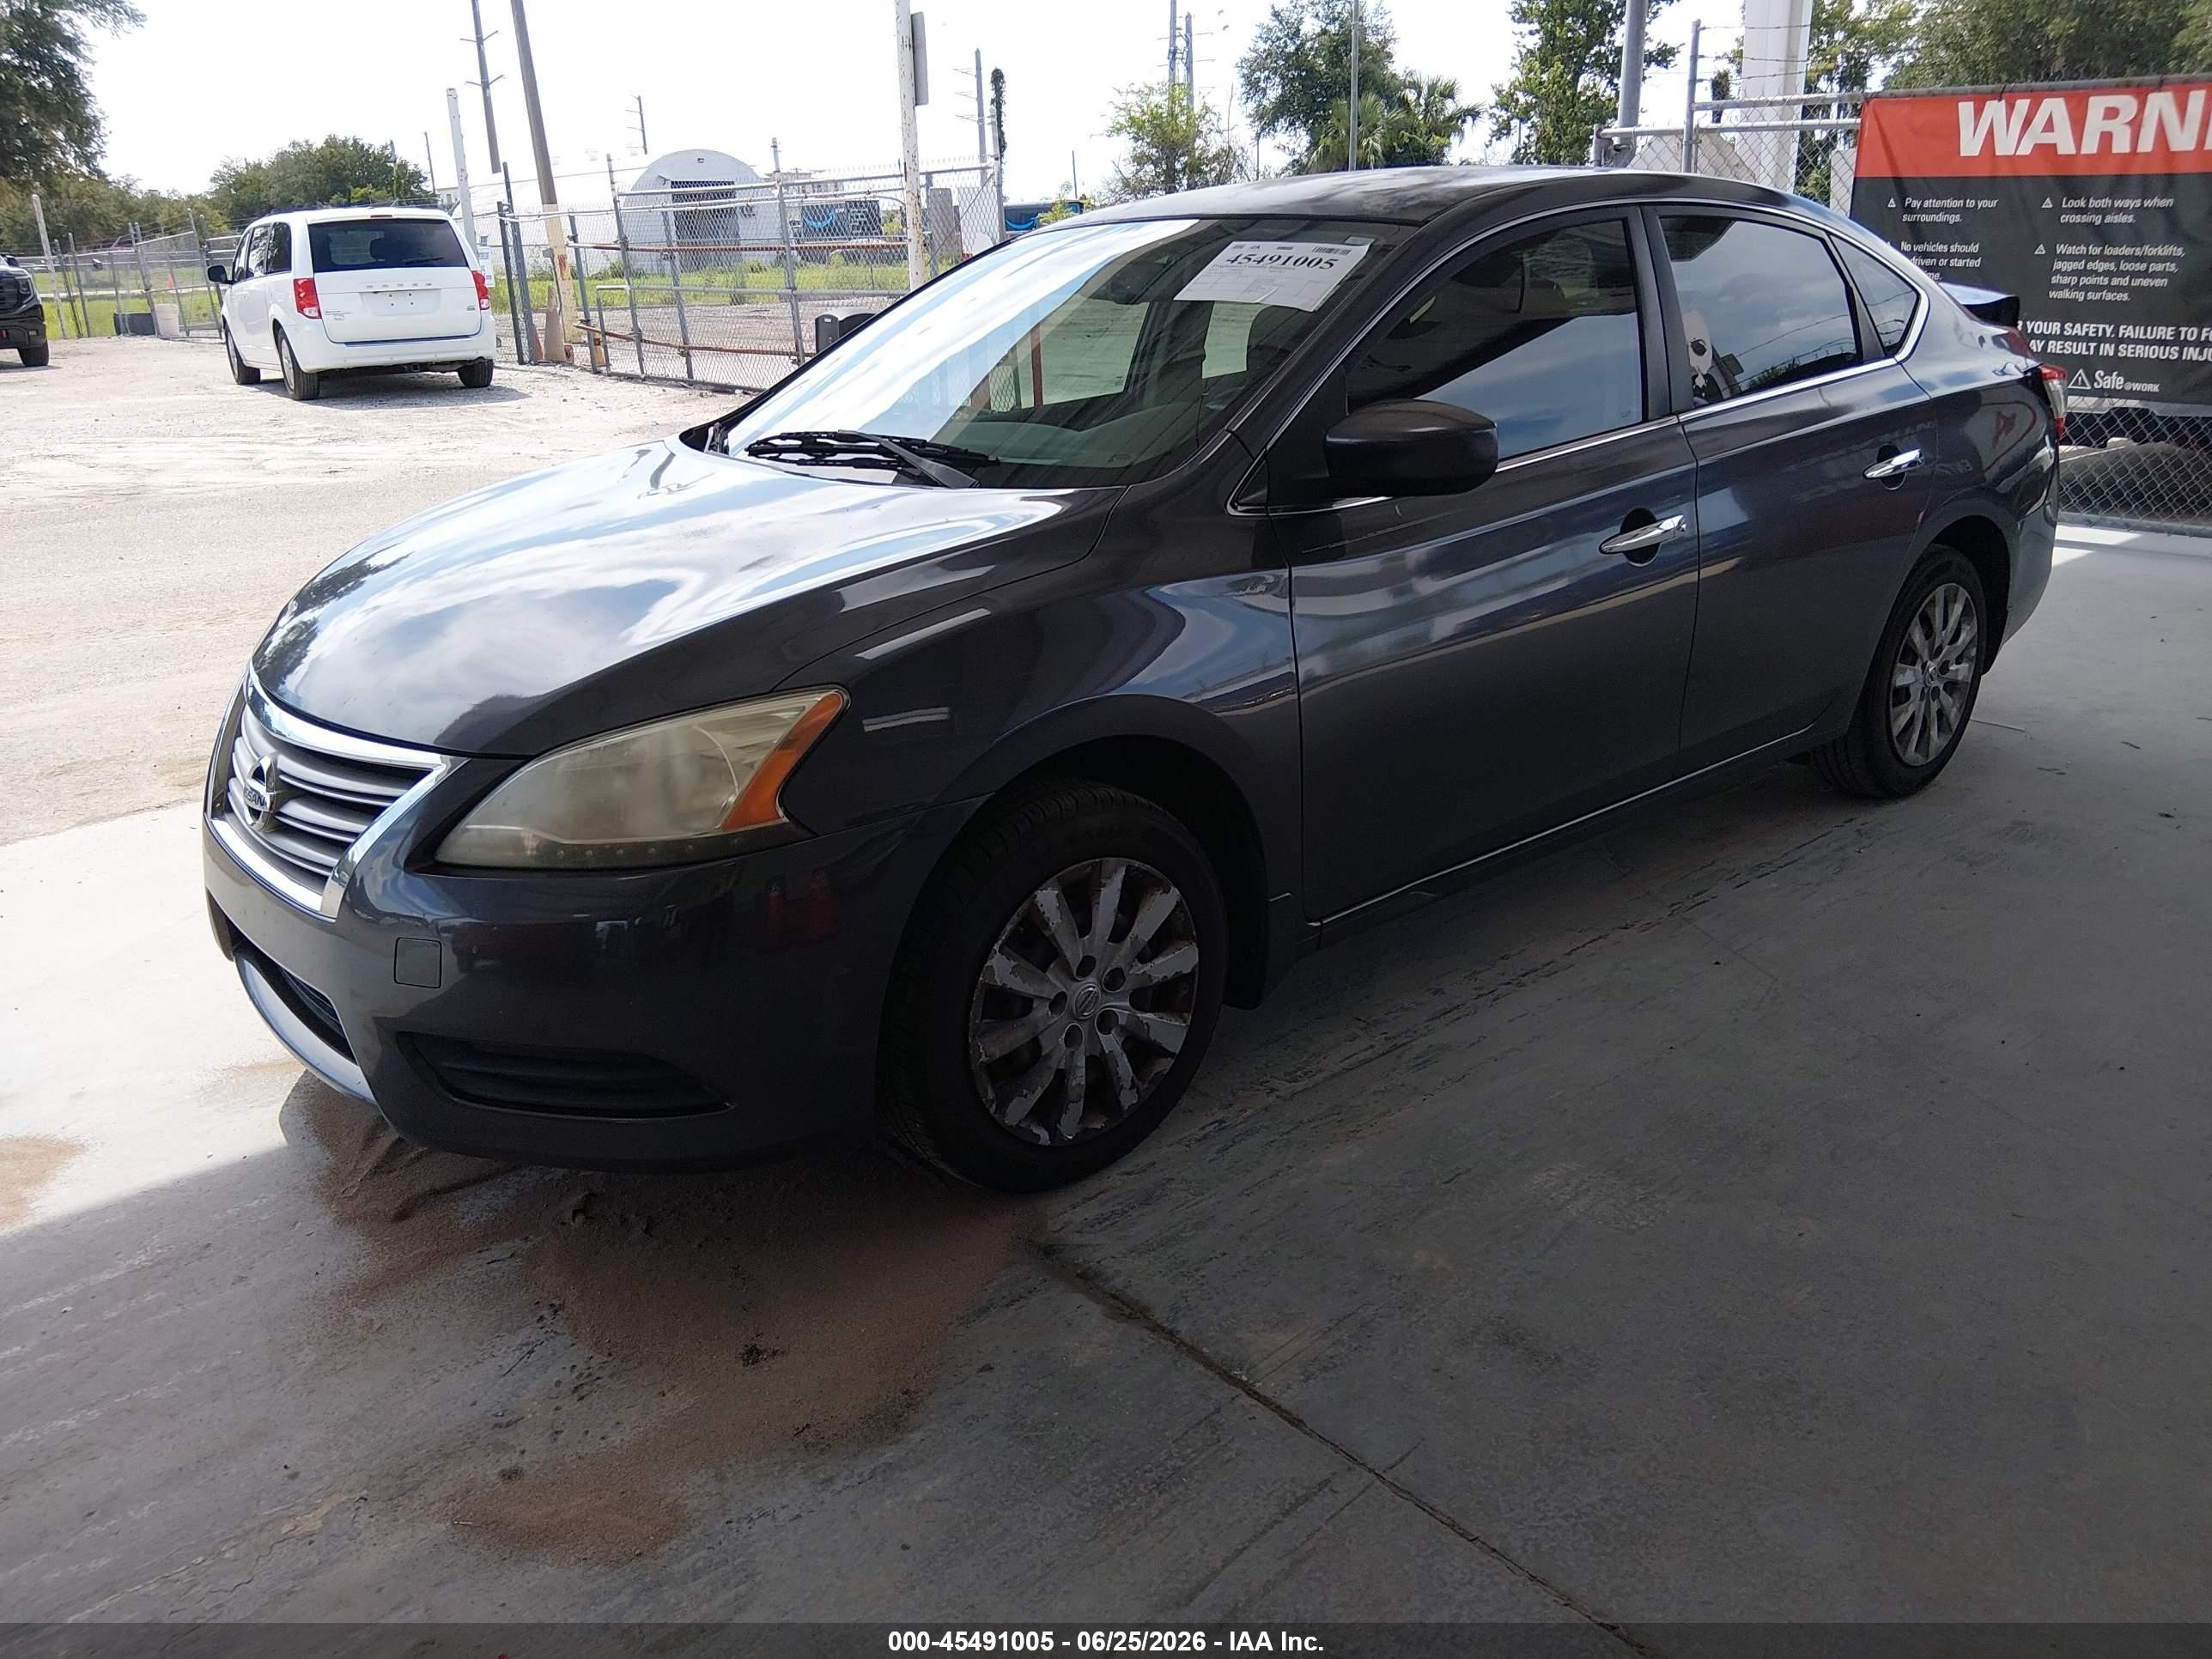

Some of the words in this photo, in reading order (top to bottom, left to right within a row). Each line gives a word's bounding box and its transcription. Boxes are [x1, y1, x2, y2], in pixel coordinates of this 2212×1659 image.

[1905, 198, 1921, 210] Pay
[1923, 198, 1965, 208] attention
[1966, 198, 1975, 208] to
[1978, 199, 1999, 210] your
[2062, 197, 2086, 208] Look
[2088, 198, 2112, 208] both
[2113, 200, 2142, 210] ways
[2143, 197, 2174, 208] when
[1903, 213, 1963, 224] surroundings.
[2061, 212, 2102, 226] crossing
[2104, 213, 2136, 223] aisles.
[1900, 241, 1911, 252] No
[1913, 241, 1948, 252] vehicles
[1950, 241, 1979, 253] should
[2056, 244, 2087, 255] Watch
[2088, 244, 2102, 255] for
[2104, 244, 2185, 258] loaders/forklifts,
[1226, 253, 1340, 270] 45491005
[1950, 257, 1982, 268] started
[2052, 258, 2085, 272] jagged
[2087, 259, 2118, 273] edges,
[2119, 260, 2147, 271] loose
[2148, 261, 2179, 273] parts,
[2051, 274, 2077, 286] sharp
[2079, 275, 2109, 287] points
[2111, 276, 2130, 286] and
[2131, 277, 2168, 288] uneven
[2049, 289, 2085, 301] walking
[2087, 289, 2131, 301] surfaces.
[2027, 320, 2061, 335] YOUR
[2063, 322, 2115, 337] SAFETY.
[2118, 325, 2176, 340] FAILURE
[2179, 326, 2198, 341] TO
[2029, 339, 2045, 353] AY
[2047, 340, 2095, 355] RESULT
[2099, 343, 2115, 356] IN
[2118, 344, 2179, 360] SERIOUS
